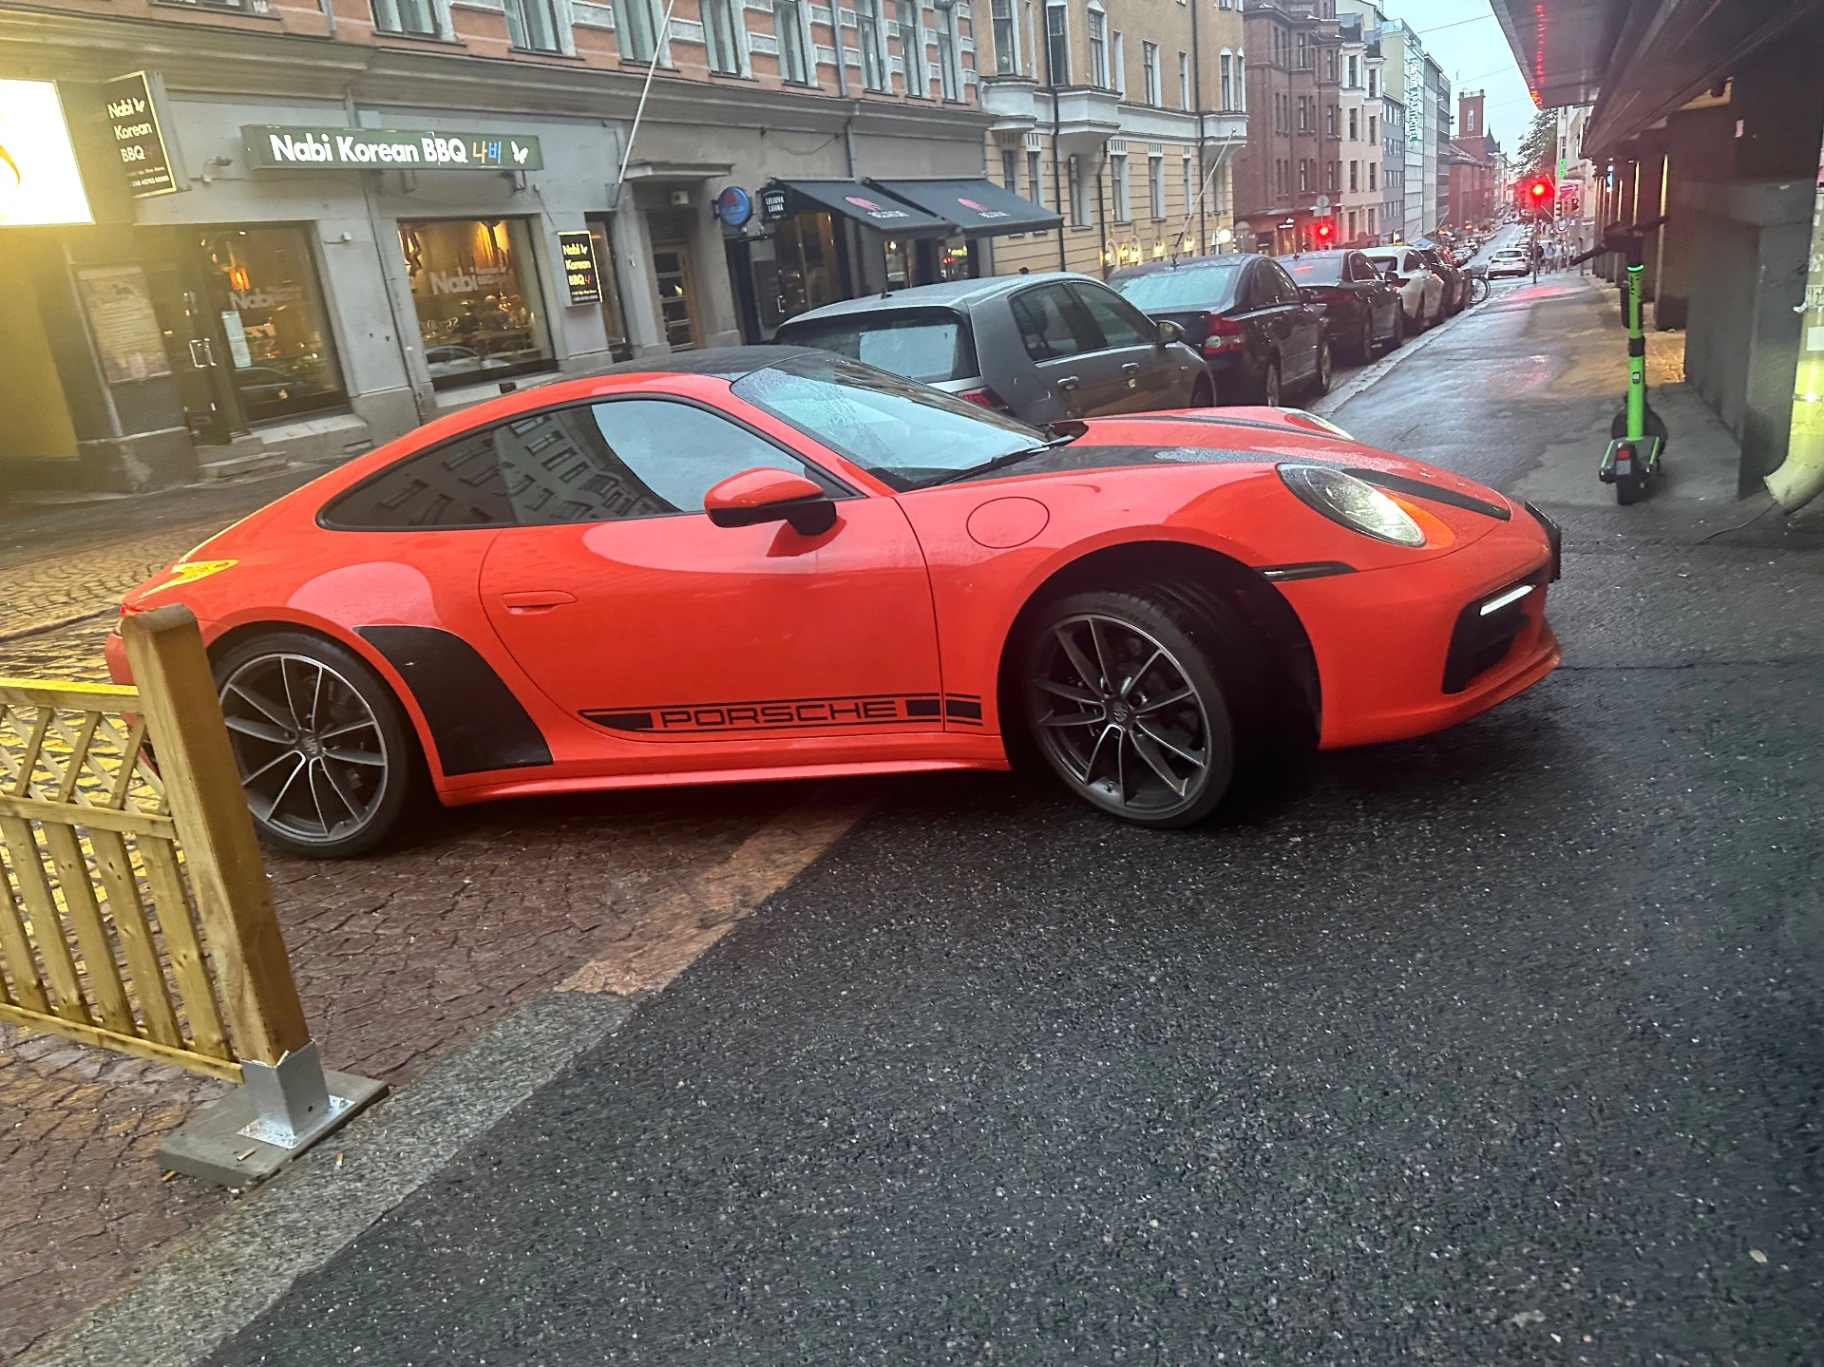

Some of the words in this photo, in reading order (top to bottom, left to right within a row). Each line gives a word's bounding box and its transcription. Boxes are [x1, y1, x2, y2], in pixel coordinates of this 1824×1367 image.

[107, 98, 135, 119] Nabi
[1409, 90, 1418, 139] APARTHOTEL
[113, 122, 153, 141] Korean
[120, 144, 146, 162] BBQ
[269, 132, 334, 162] Nabi
[335, 135, 420, 163] Korean
[421, 137, 469, 164] BBQ
[562, 243, 581, 256] Nabi
[565, 259, 592, 271] Korean
[429, 266, 479, 295] Nabi
[568, 273, 586, 286] BBQ
[228, 287, 275, 310] Nabi
[660, 700, 898, 728] PORSCHE
